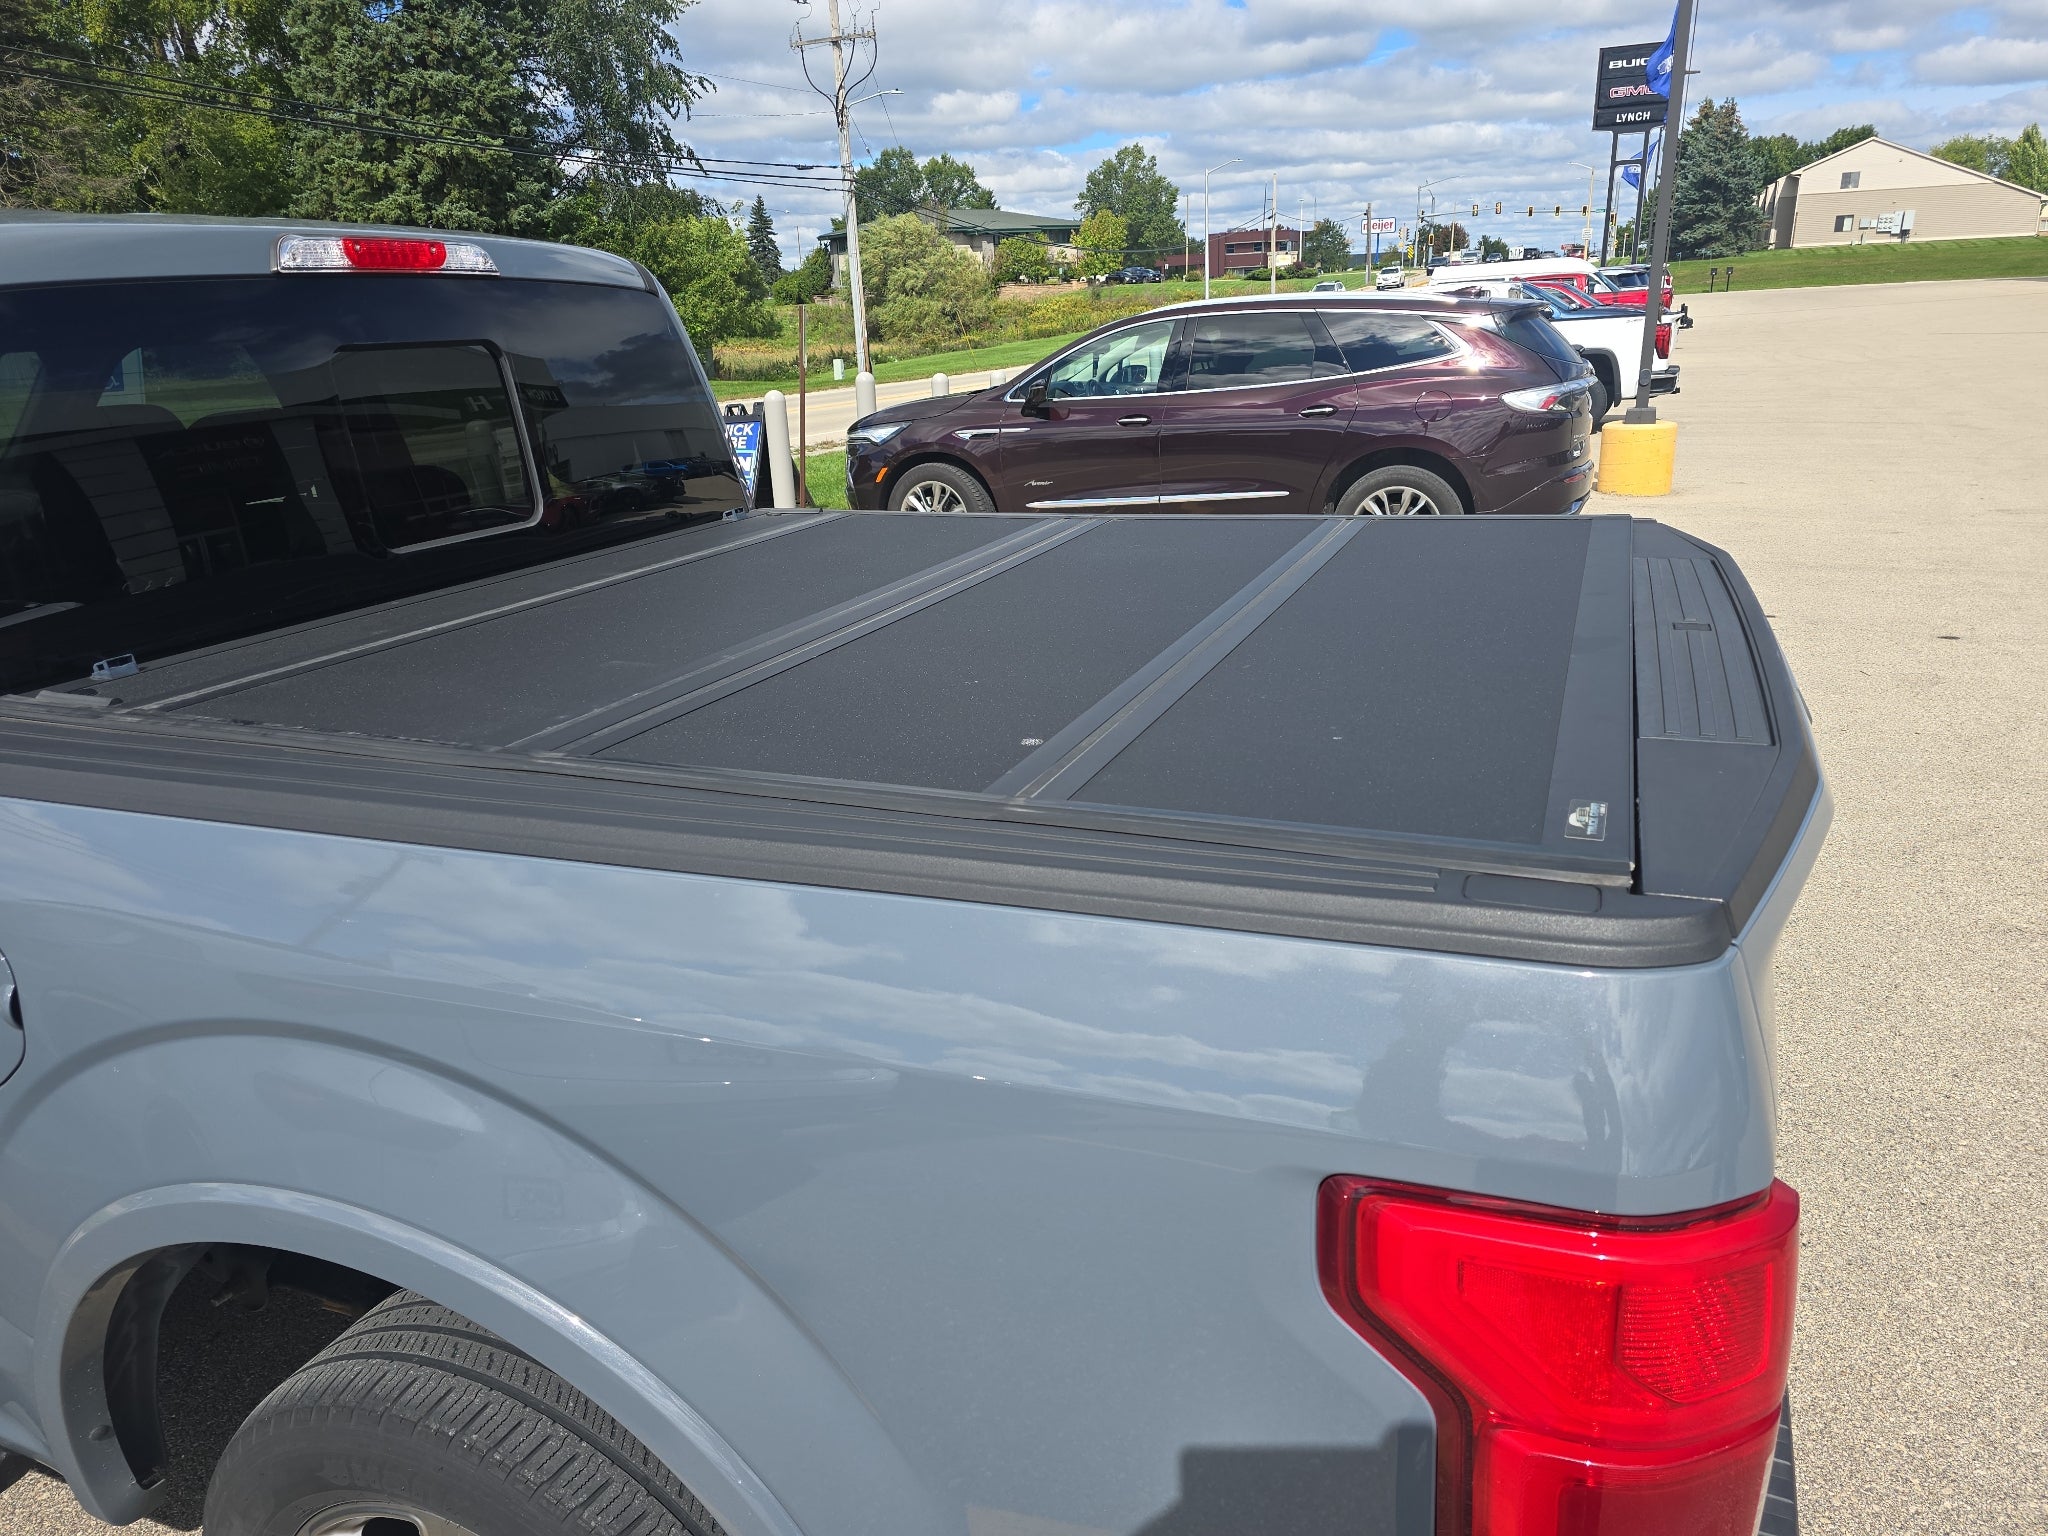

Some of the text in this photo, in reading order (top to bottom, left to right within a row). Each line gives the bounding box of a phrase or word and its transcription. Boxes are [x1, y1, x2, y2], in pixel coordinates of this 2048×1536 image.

[1608, 57, 1650, 69] BUIC
[1616, 111, 1651, 122] LYNCH
[731, 436, 748, 449] BE
